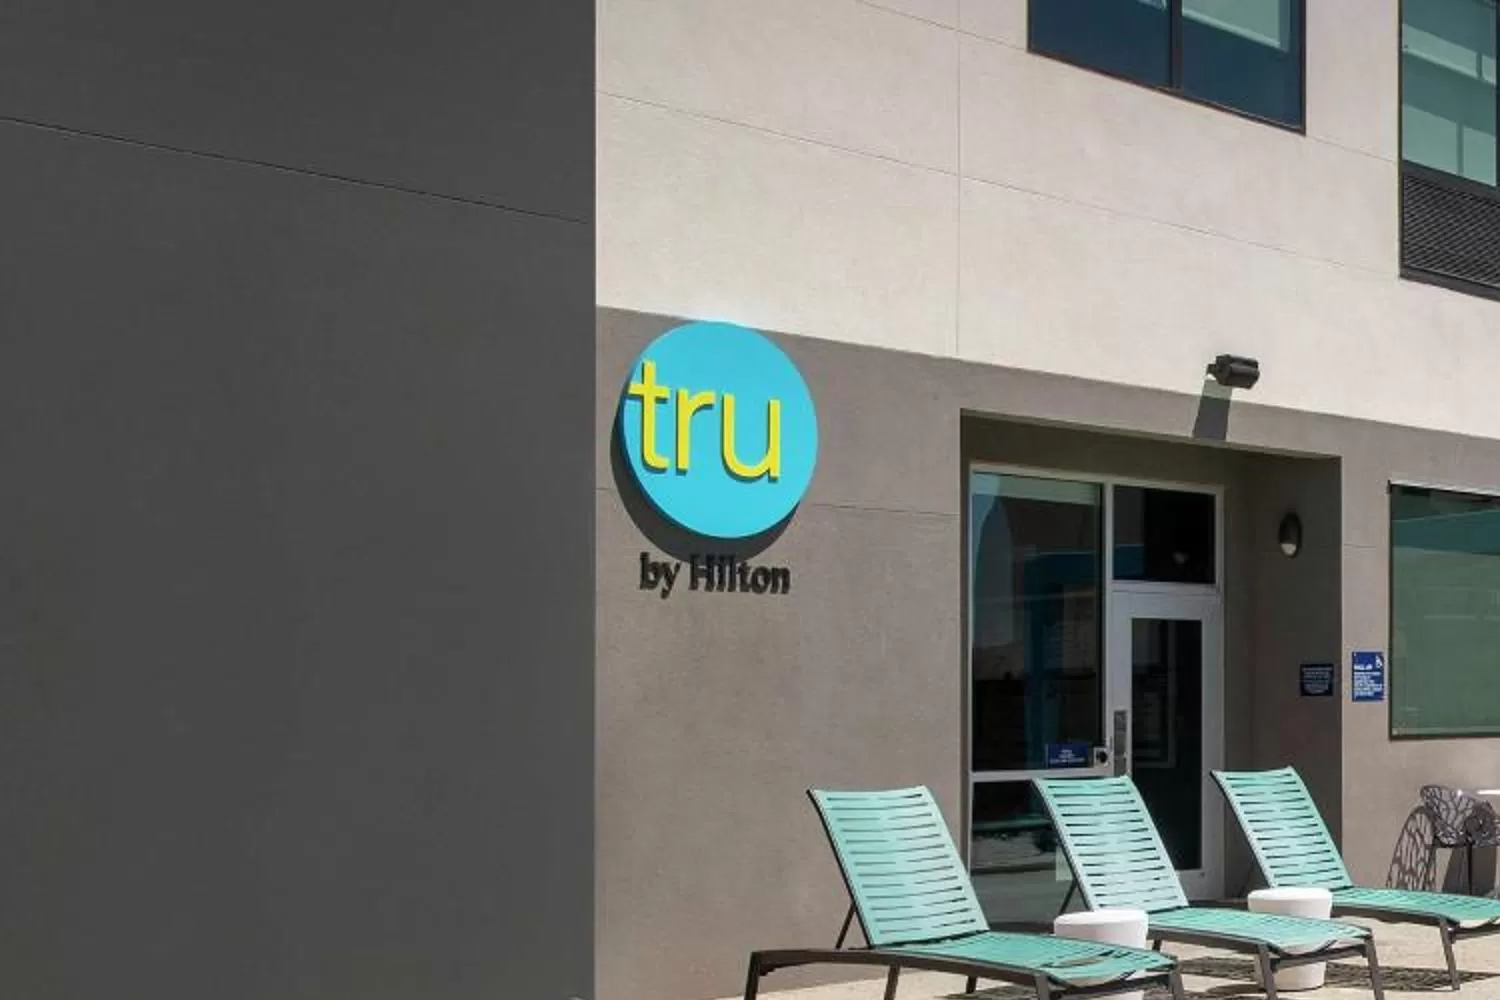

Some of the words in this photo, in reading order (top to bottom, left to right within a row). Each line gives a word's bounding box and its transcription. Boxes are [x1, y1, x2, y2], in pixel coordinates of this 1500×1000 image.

[628, 360, 781, 480] tru
[639, 552, 681, 600] by
[689, 553, 792, 594] Hilton
